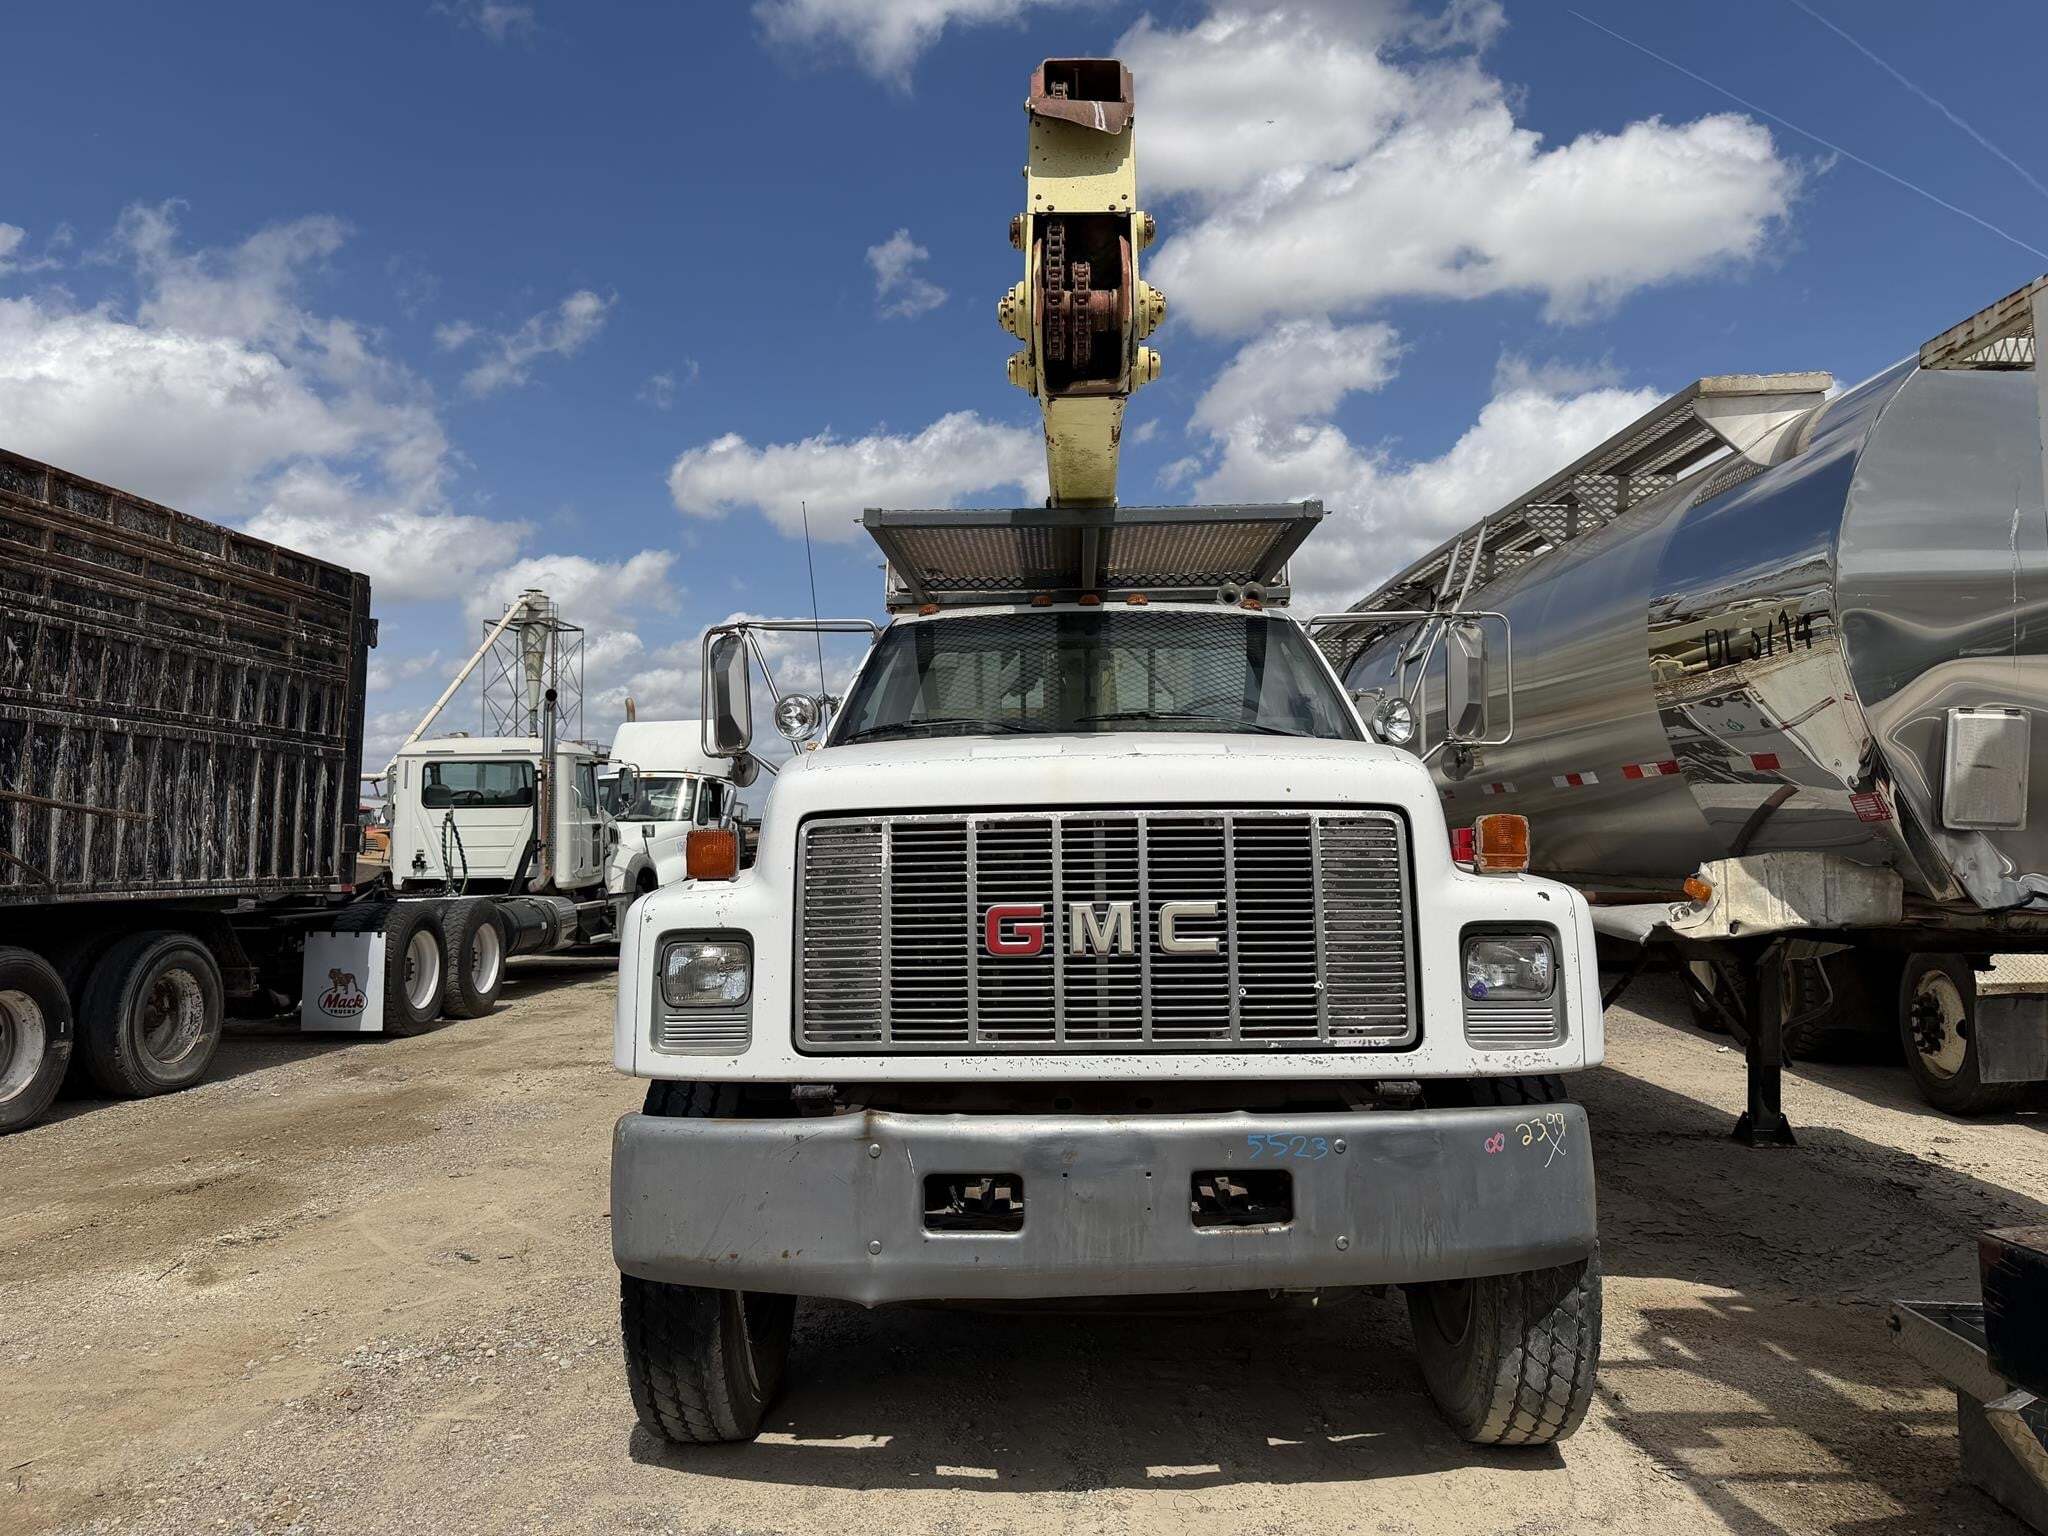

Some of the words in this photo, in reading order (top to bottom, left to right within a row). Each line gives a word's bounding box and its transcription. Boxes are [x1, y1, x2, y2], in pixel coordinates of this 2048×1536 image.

[985, 902, 1220, 957] GMC
[323, 993, 364, 1009] Mack
[1247, 1131, 1329, 1160] 5523
